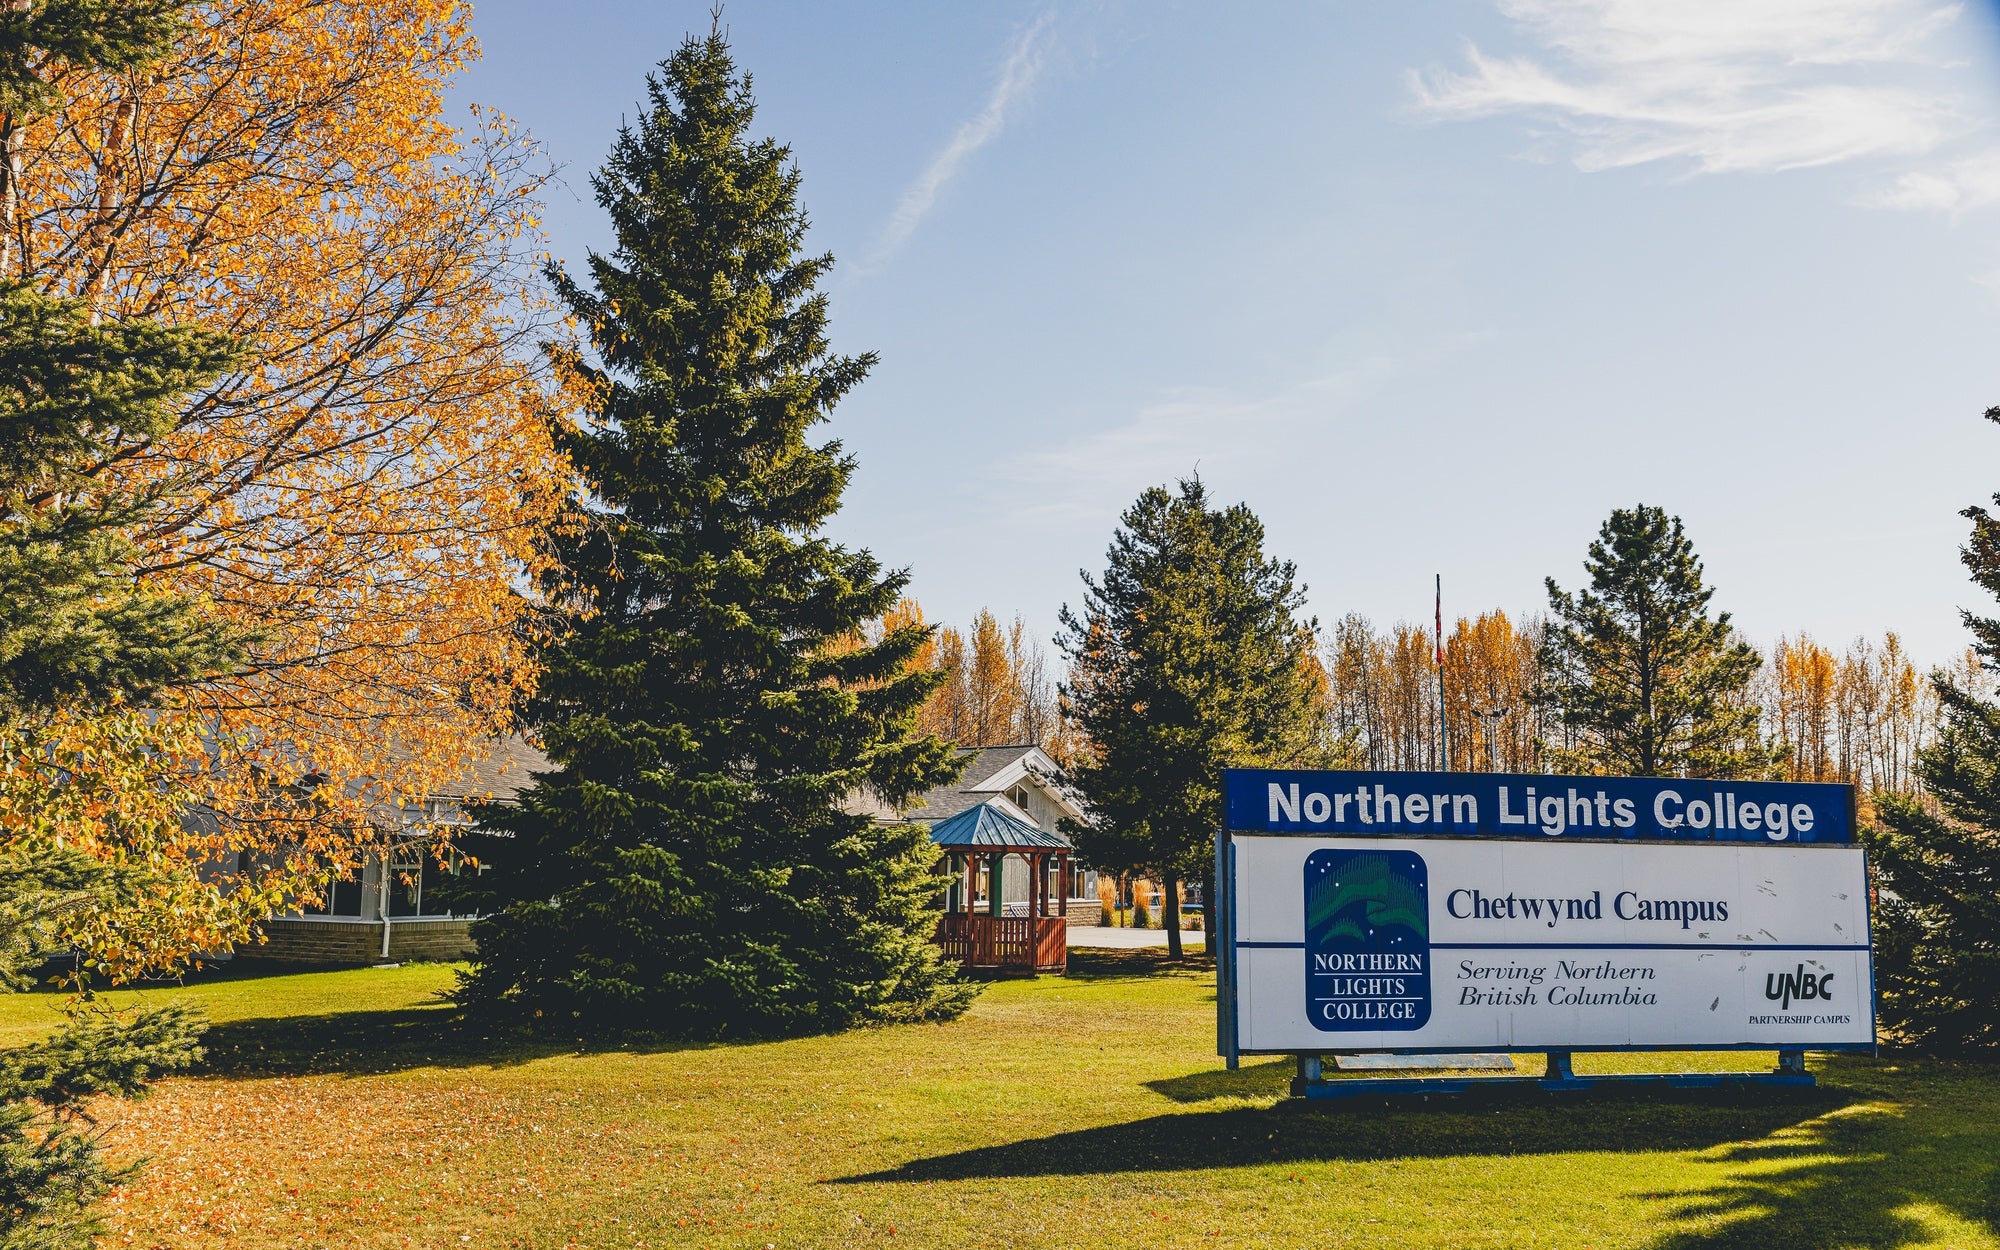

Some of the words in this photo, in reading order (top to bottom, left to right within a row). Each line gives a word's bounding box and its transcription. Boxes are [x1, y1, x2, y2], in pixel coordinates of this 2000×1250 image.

[1268, 783, 1478, 824] Northern
[1499, 787, 1636, 835] Lights
[1654, 790, 1814, 841] College
[1447, 889, 1602, 928] Chetwynd
[1614, 891, 1728, 929] Campus
[1315, 954, 1421, 970] NORTHERN
[1457, 960, 1546, 985] Serving
[1554, 961, 1656, 979] Northern
[1334, 979, 1404, 994] LIGHTS
[1458, 986, 1538, 1005] British
[1548, 986, 1657, 1005] Columbia
[1766, 963, 1834, 1010] UNBC
[1324, 1003, 1415, 1019] COLLEGE
[1748, 1015, 1812, 1025] PARTNERSHIP
[1813, 1015, 1851, 1025] CAMPUS
